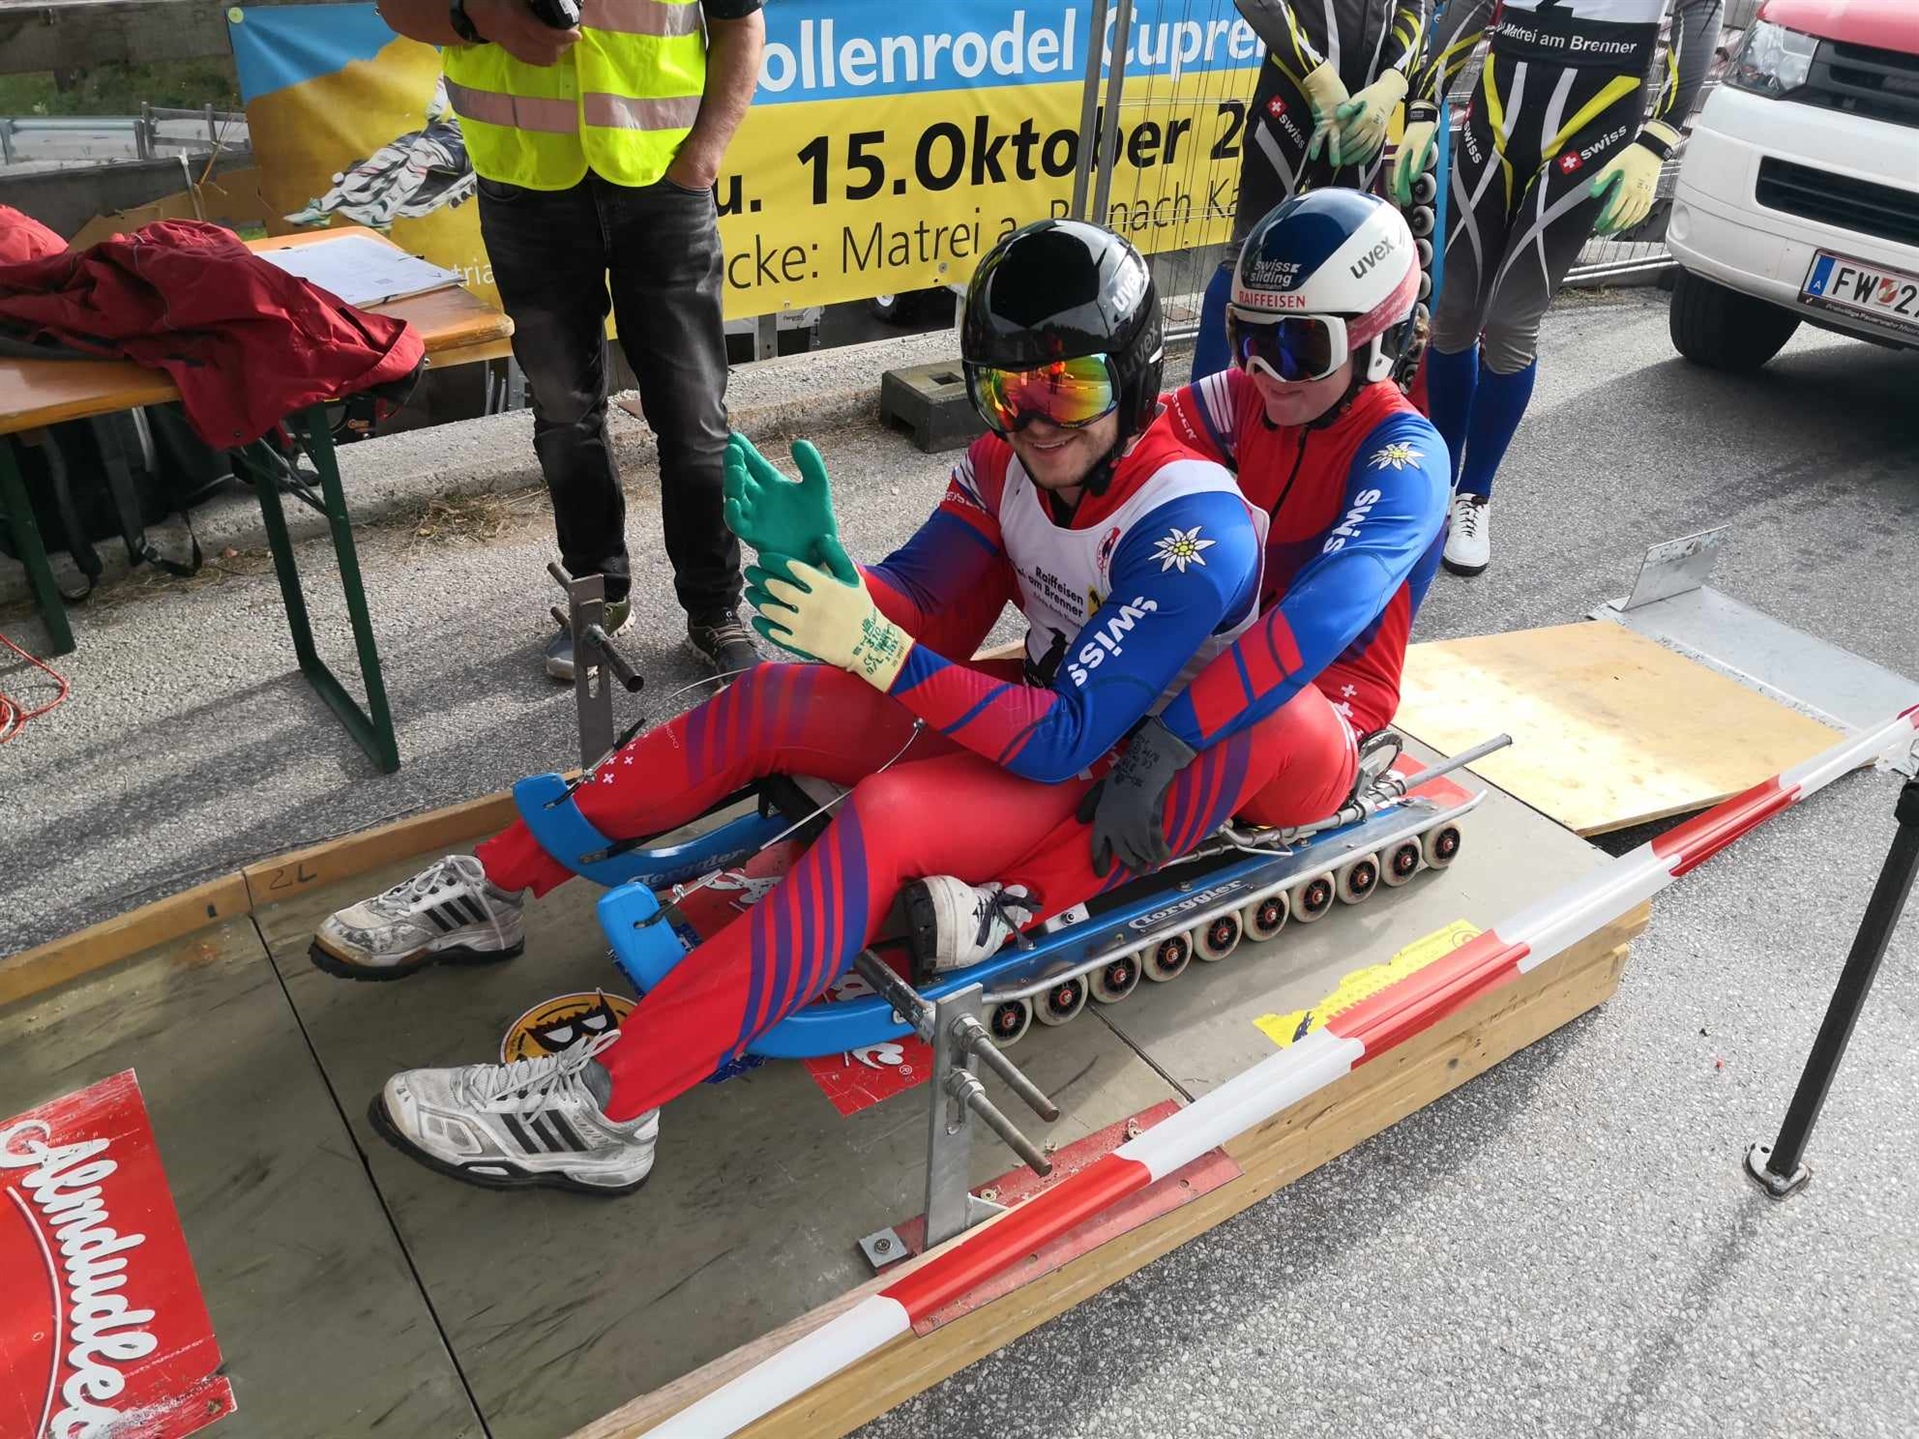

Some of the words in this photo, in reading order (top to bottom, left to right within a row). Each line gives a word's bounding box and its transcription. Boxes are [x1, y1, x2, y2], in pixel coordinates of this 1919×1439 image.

[755, 8, 1077, 93] ollenrodel
[1540, 34, 1565, 48] am
[1570, 35, 1637, 54] Brenner
[1279, 114, 1306, 149] swiss
[1463, 120, 1482, 164] swiss
[1580, 125, 1627, 160] swiss
[728, 234, 818, 290] cke:
[842, 206, 980, 273] Matrei
[1109, 181, 1190, 233] nach
[1250, 270, 1293, 287] sliding
[1253, 258, 1291, 273] swiss
[1350, 236, 1396, 279] uvex
[1239, 290, 1305, 308] RAIFFEISEN
[1832, 267, 1880, 303] FW
[1893, 284, 1919, 318] 2
[1323, 489, 1381, 554] swis
[1035, 565, 1084, 606] Raiffeisen
[1044, 584, 1084, 618] Brenner
[1067, 596, 1158, 687] swiss
[1128, 880, 1243, 929] Torggler
